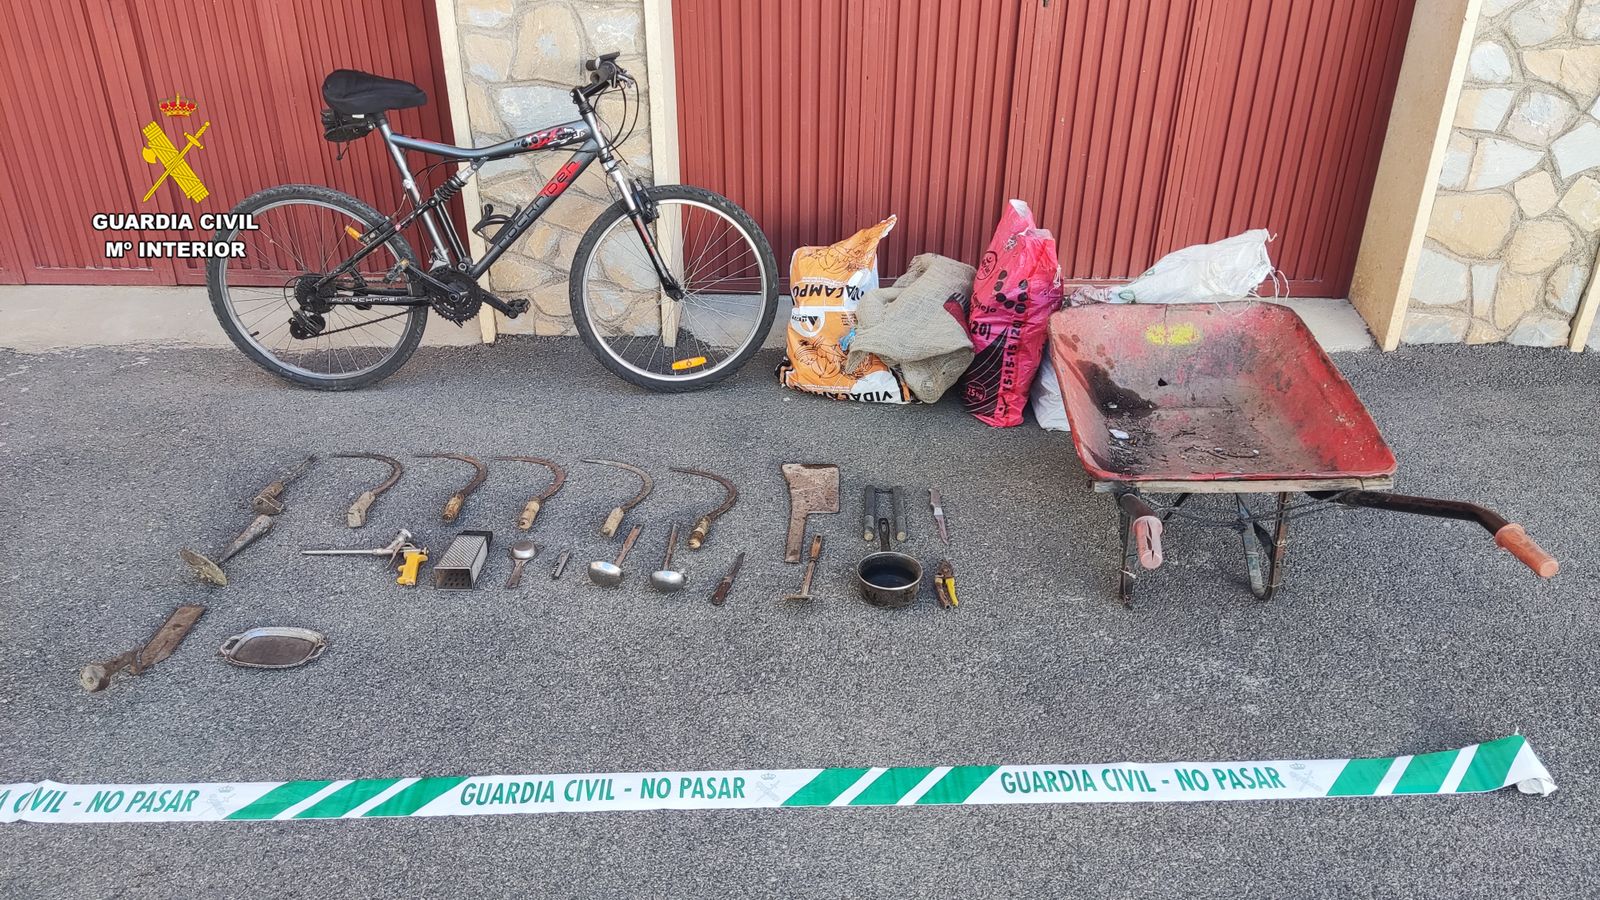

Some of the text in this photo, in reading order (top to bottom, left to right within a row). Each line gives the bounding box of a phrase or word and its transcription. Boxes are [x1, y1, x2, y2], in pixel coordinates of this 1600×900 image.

[460, 780, 555, 806] GUARDIA
[564, 778, 615, 801] CIVIL
[640, 777, 671, 799] NO
[679, 776, 745, 799] PASAR
[1001, 769, 1098, 794] GUARDIA
[1101, 768, 1157, 792] CIVIL
[1174, 768, 1210, 792] NO
[1212, 766, 1286, 790] PASAR
[85, 790, 124, 813] NO
[125, 789, 200, 813] PASAR
